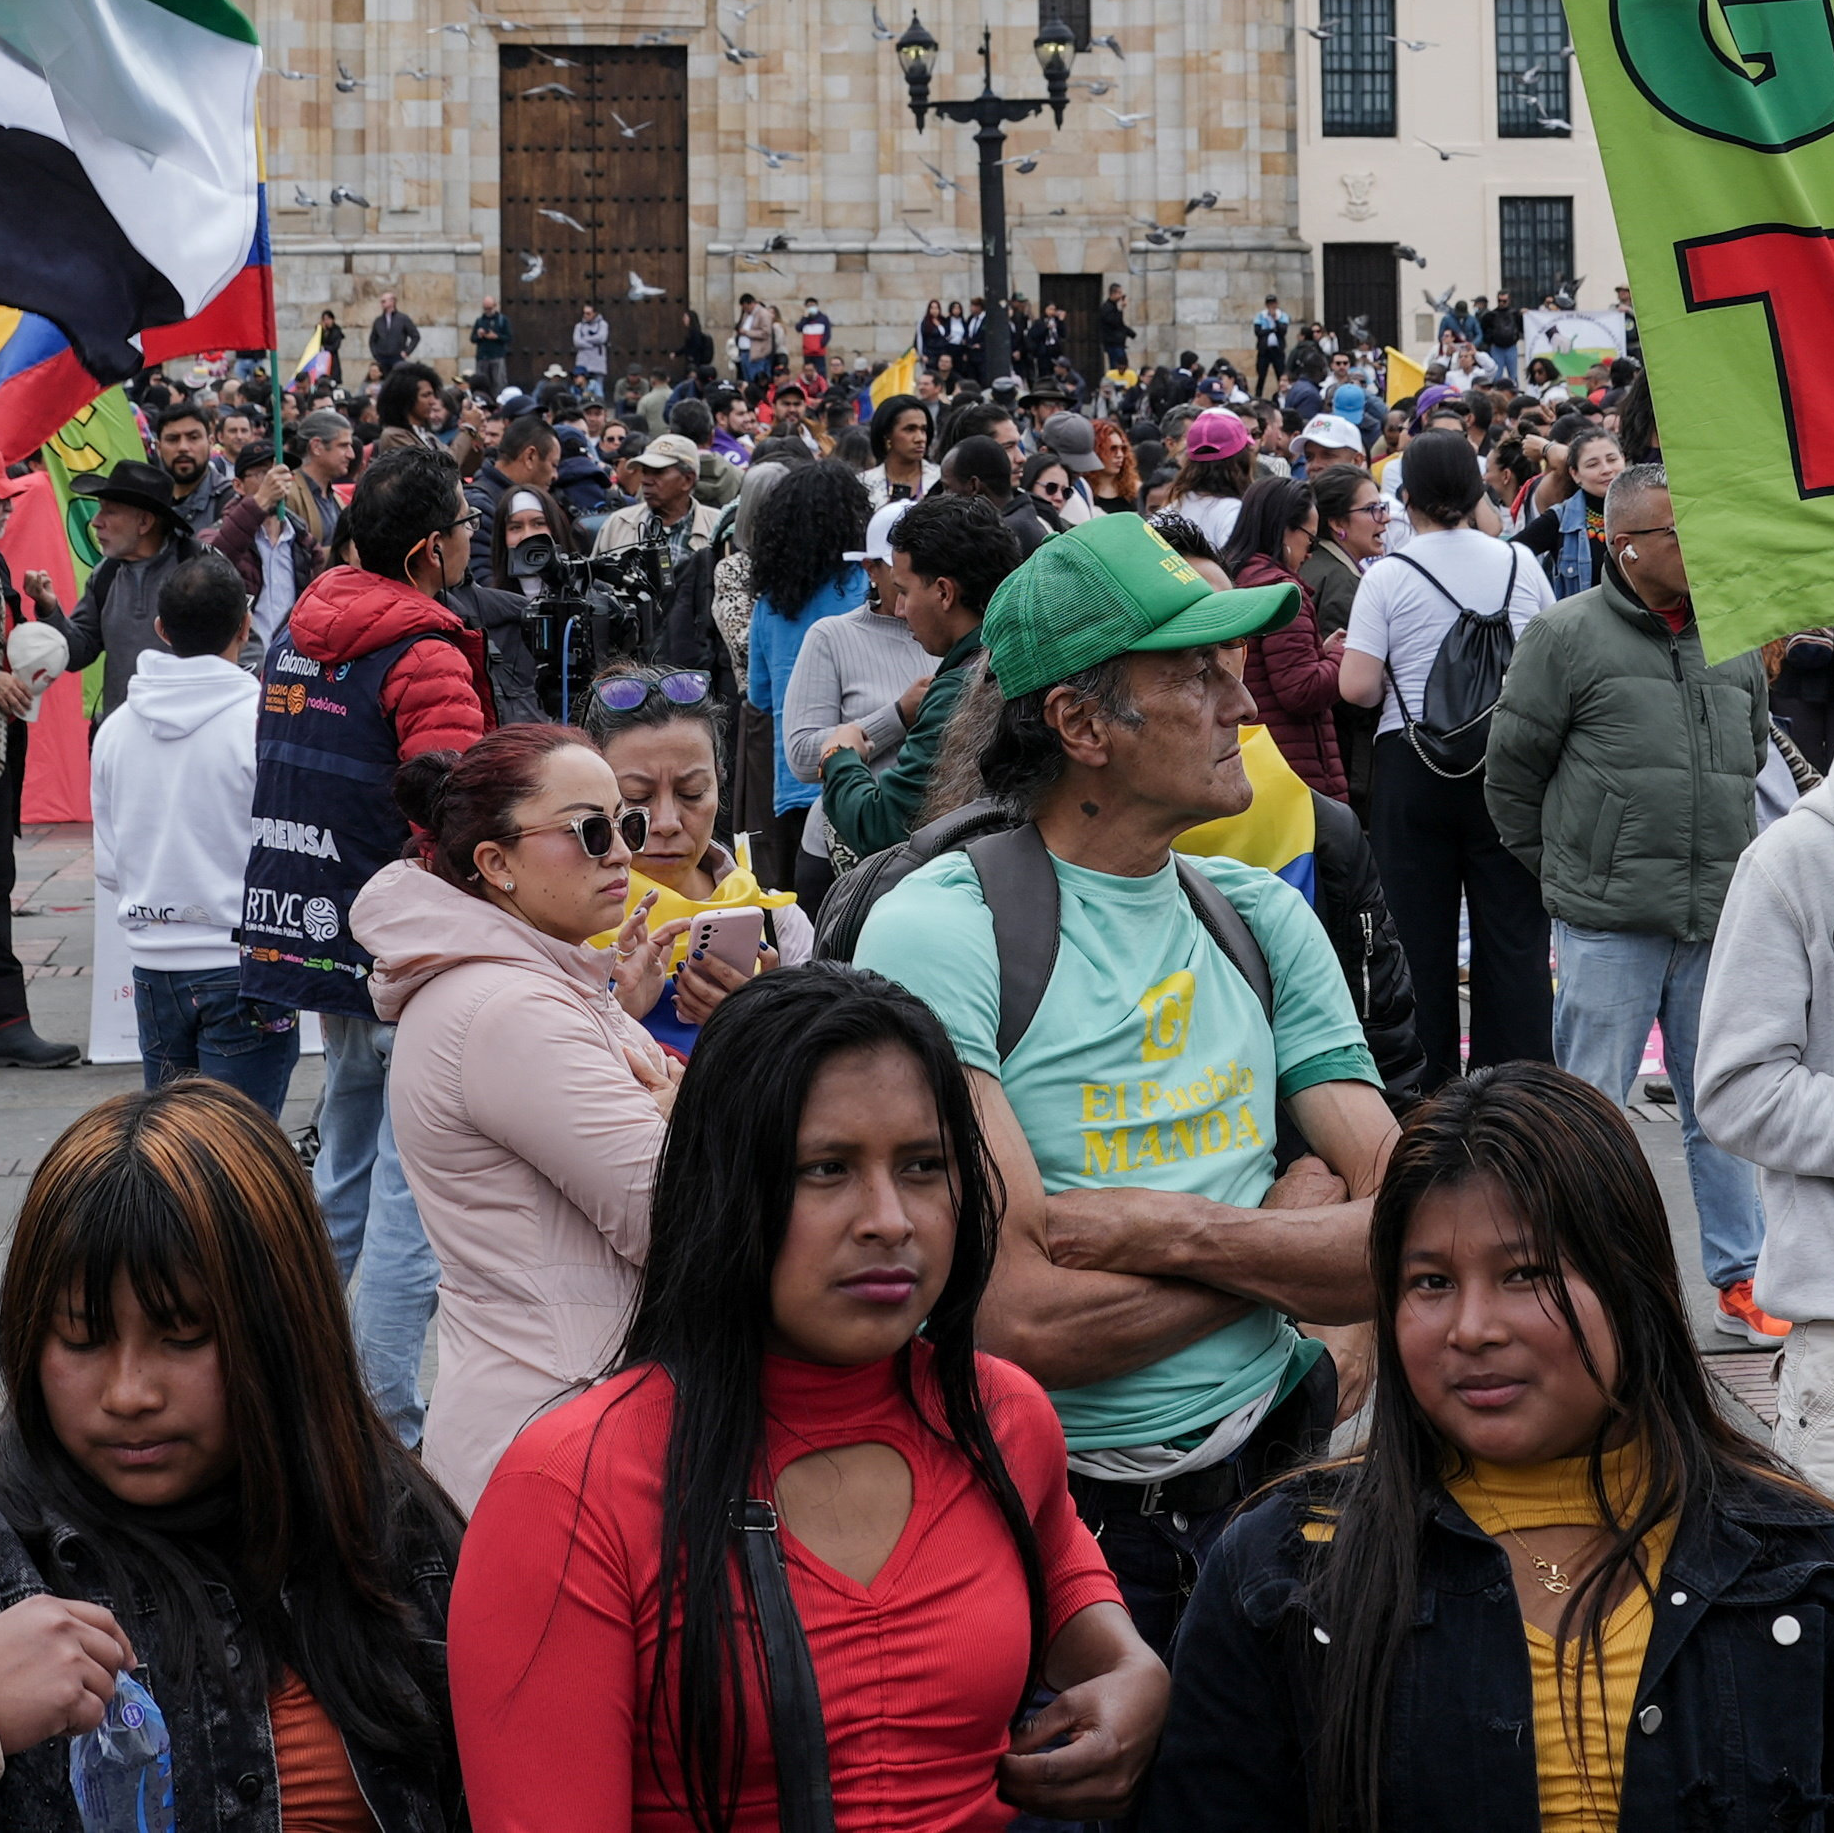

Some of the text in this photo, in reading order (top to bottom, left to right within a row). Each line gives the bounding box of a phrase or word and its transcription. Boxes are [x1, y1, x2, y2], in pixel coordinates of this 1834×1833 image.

[276, 649, 320, 677] Colombia
[251, 817, 341, 863] PRENSA
[246, 887, 302, 928] RTVC
[1079, 1059, 1254, 1123] El Pueblo
[1079, 1103, 1266, 1176] MANDA
